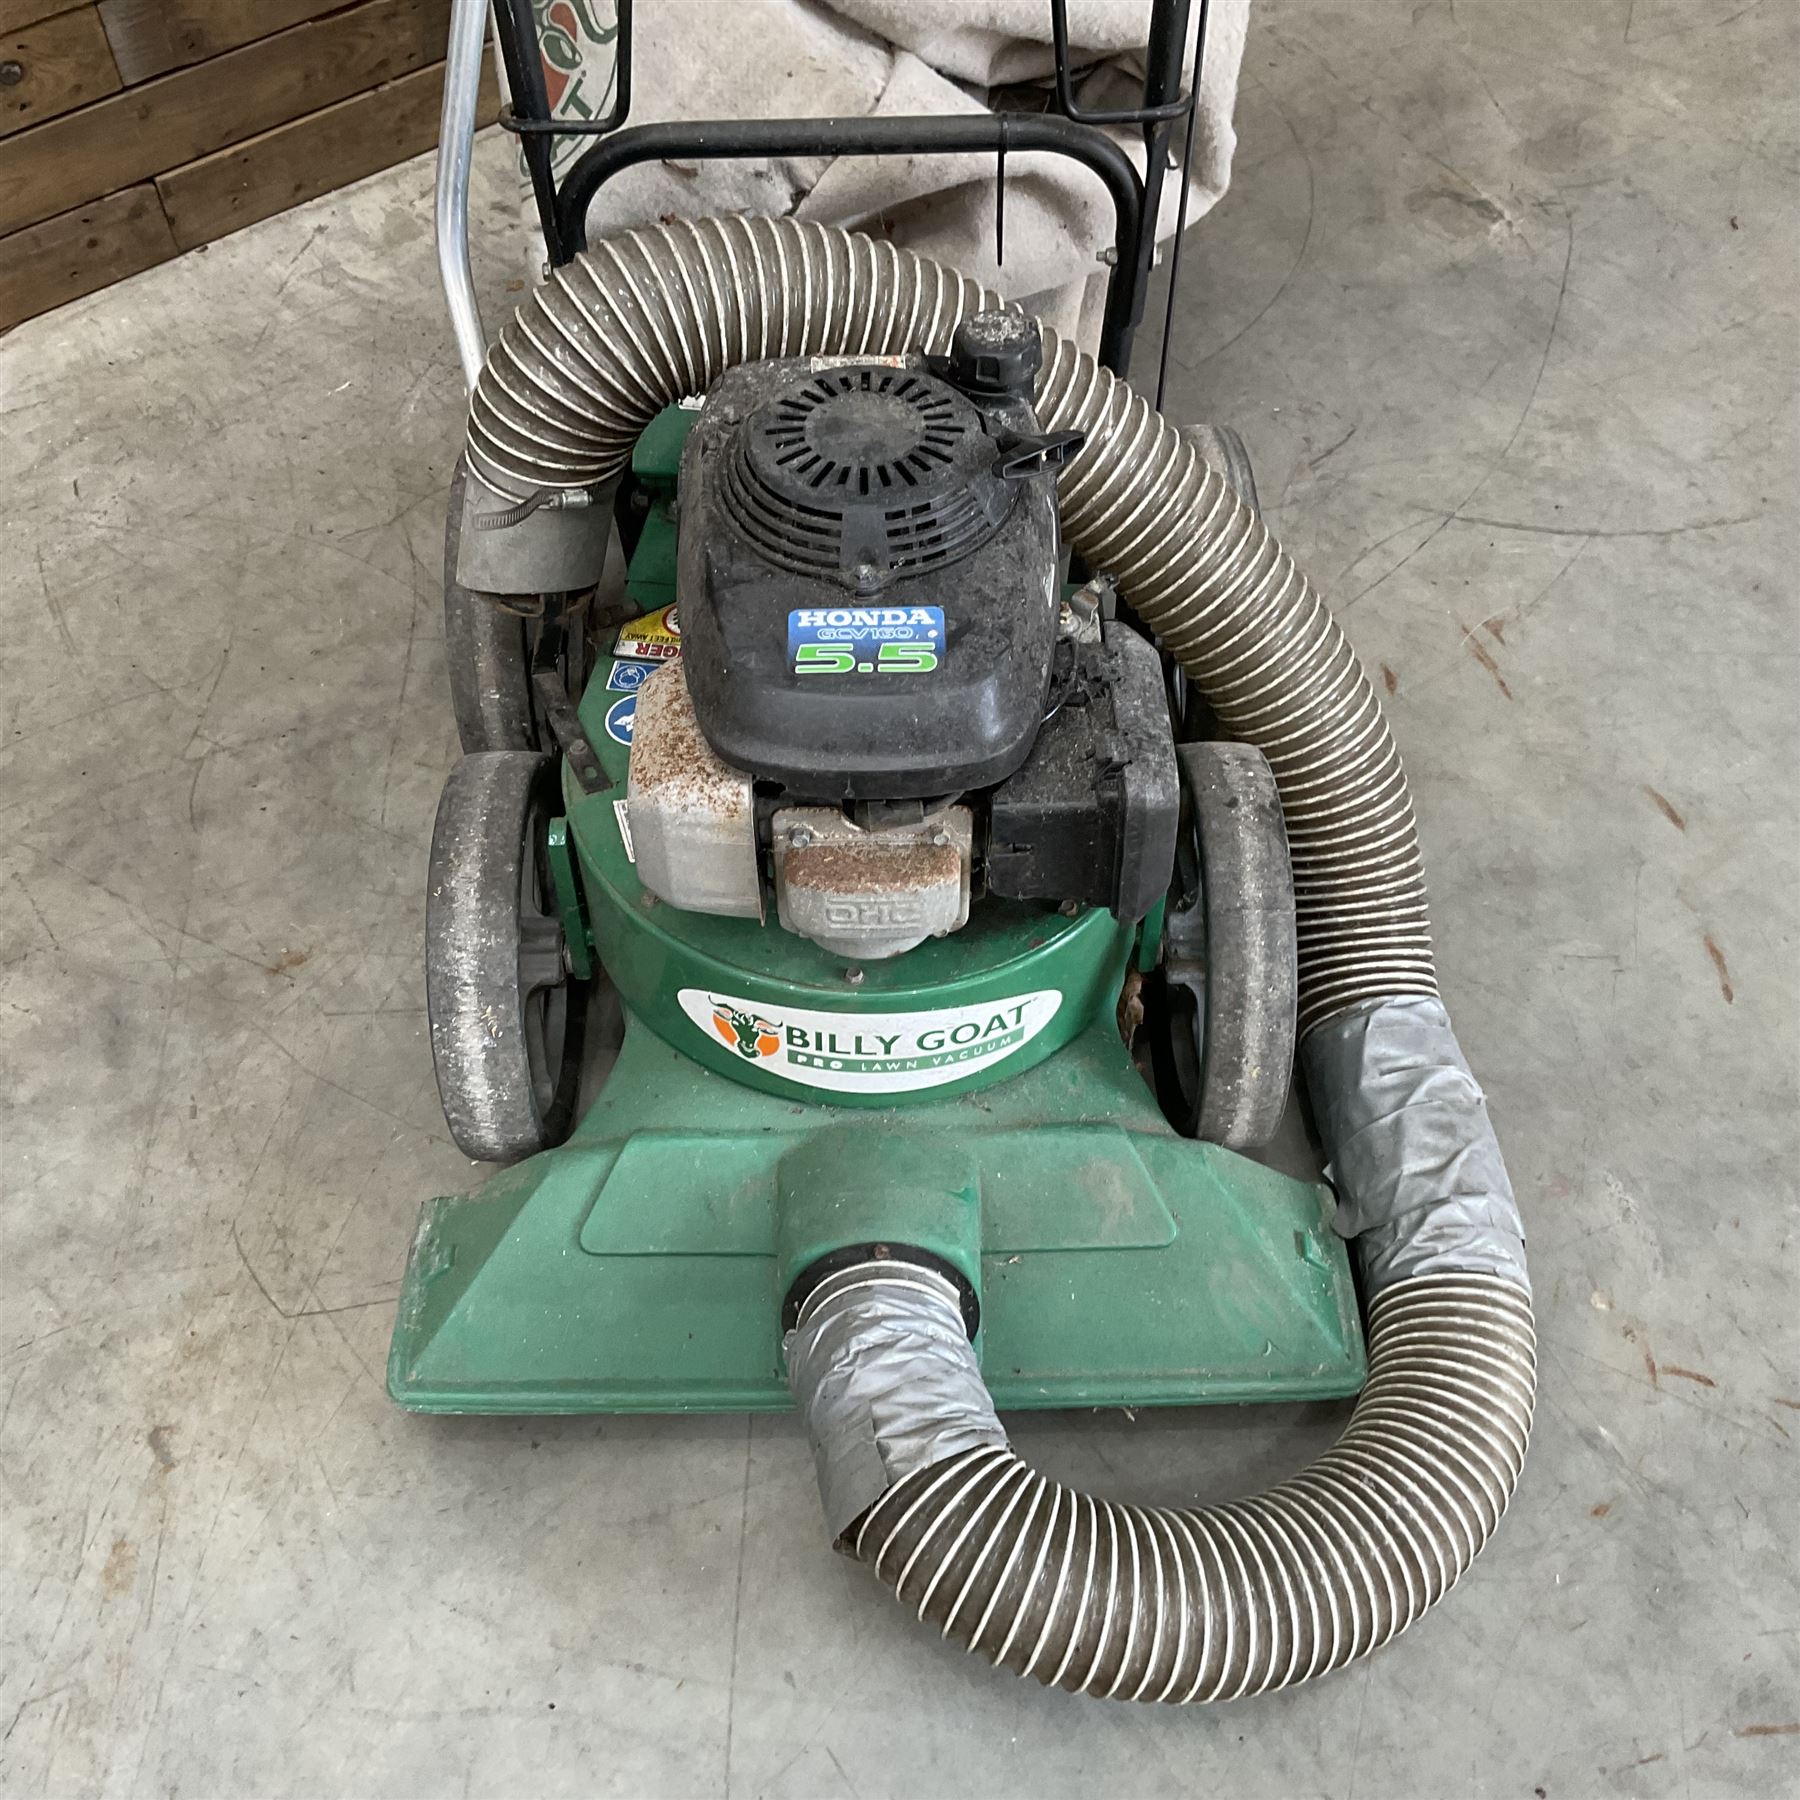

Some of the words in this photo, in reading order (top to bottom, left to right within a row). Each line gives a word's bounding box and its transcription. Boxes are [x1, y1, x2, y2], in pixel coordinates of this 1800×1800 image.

[798, 608, 935, 627] HONDA
[635, 642, 683, 658] GER
[795, 642, 938, 674] 5.5
[786, 1025, 902, 1055] BILLY
[916, 1000, 1031, 1051] GOAT
[797, 1055, 843, 1070] PRO
[861, 1061, 917, 1072] LAWN
[932, 1036, 1012, 1066] VACUUM
